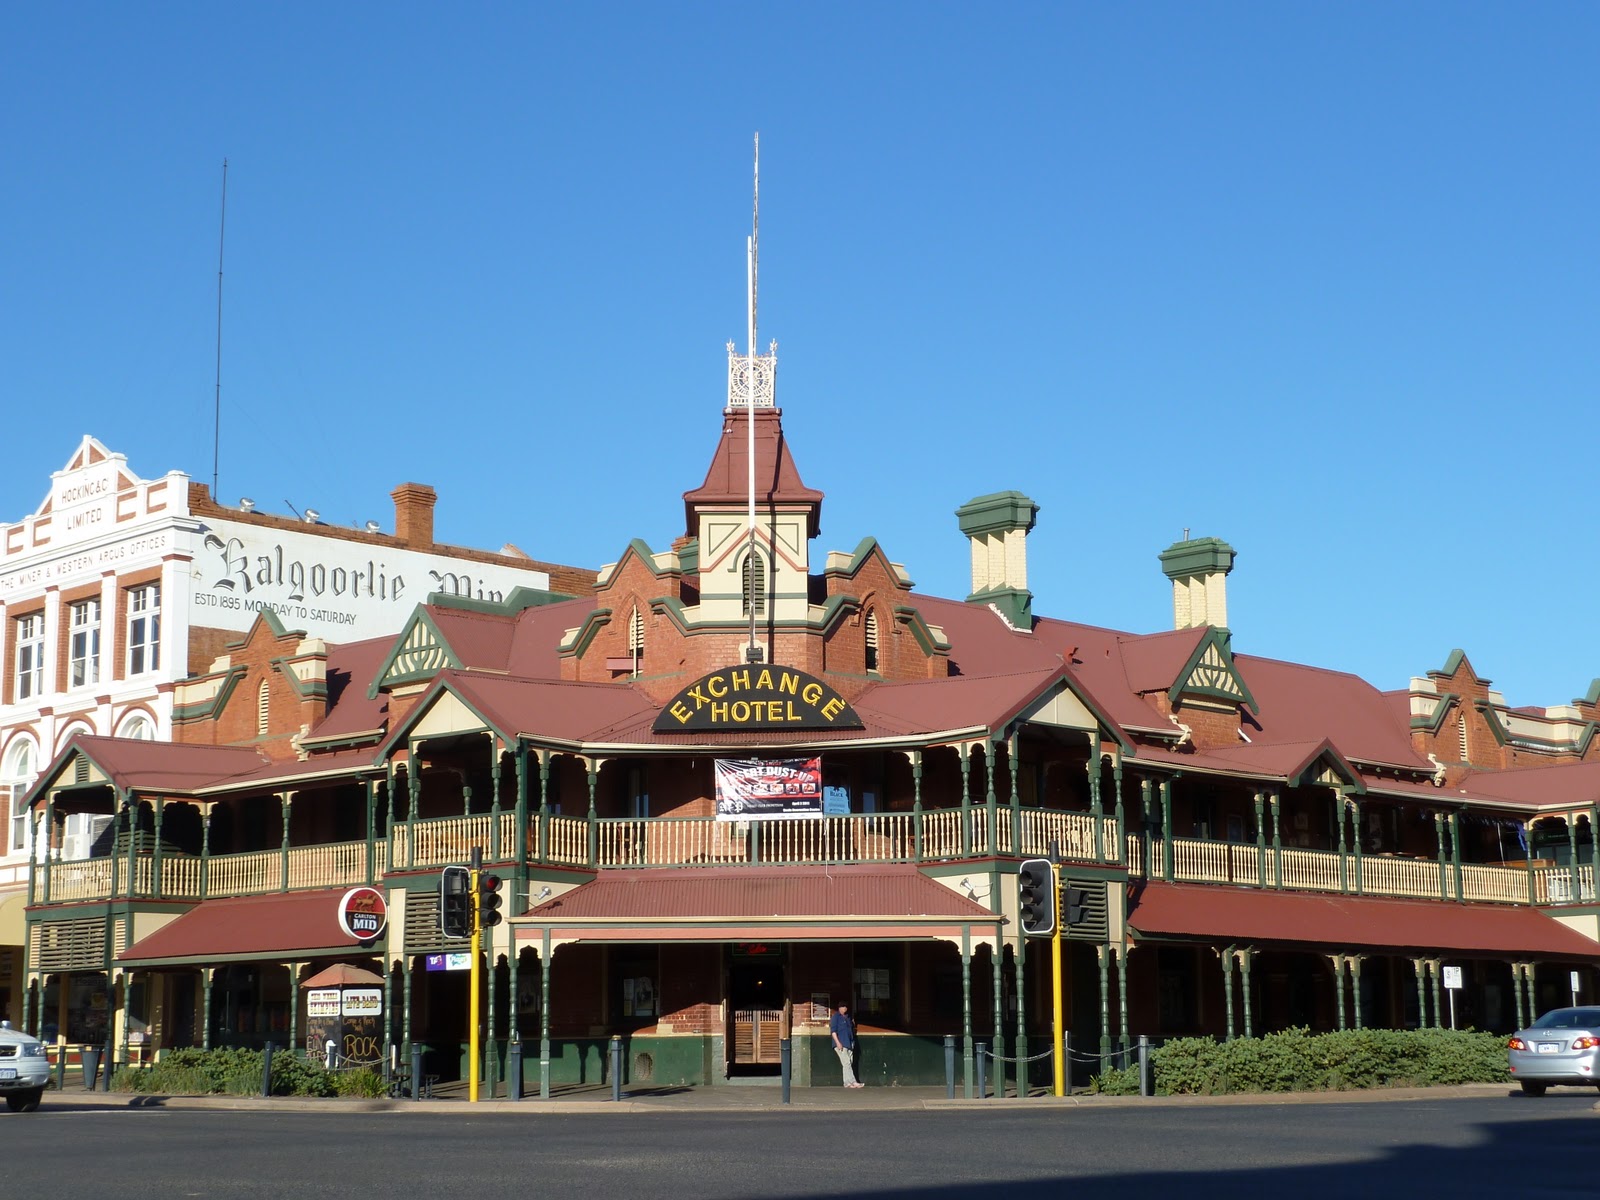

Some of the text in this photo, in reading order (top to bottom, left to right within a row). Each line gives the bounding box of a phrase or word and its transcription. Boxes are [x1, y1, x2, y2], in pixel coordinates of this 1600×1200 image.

[67, 508, 102, 530] LIMITED
[1, 577, 14, 591] THE
[20, 569, 41, 584] MINER
[57, 556, 93, 575] WESTERN
[99, 546, 125, 563] ARGUS
[130, 535, 166, 555] OFFICES
[204, 534, 406, 602] Kalgoorlie
[244, 599, 294, 616] MONDAY
[295, 606, 307, 619] TO
[309, 608, 357, 625] SATURDAY
[669, 669, 846, 725] EXCHANGE
[711, 700, 802, 723] HOTEL
[353, 918, 378, 930] MID
[354, 912, 377, 920] CARLTON
[343, 1034, 384, 1061] ROCK
